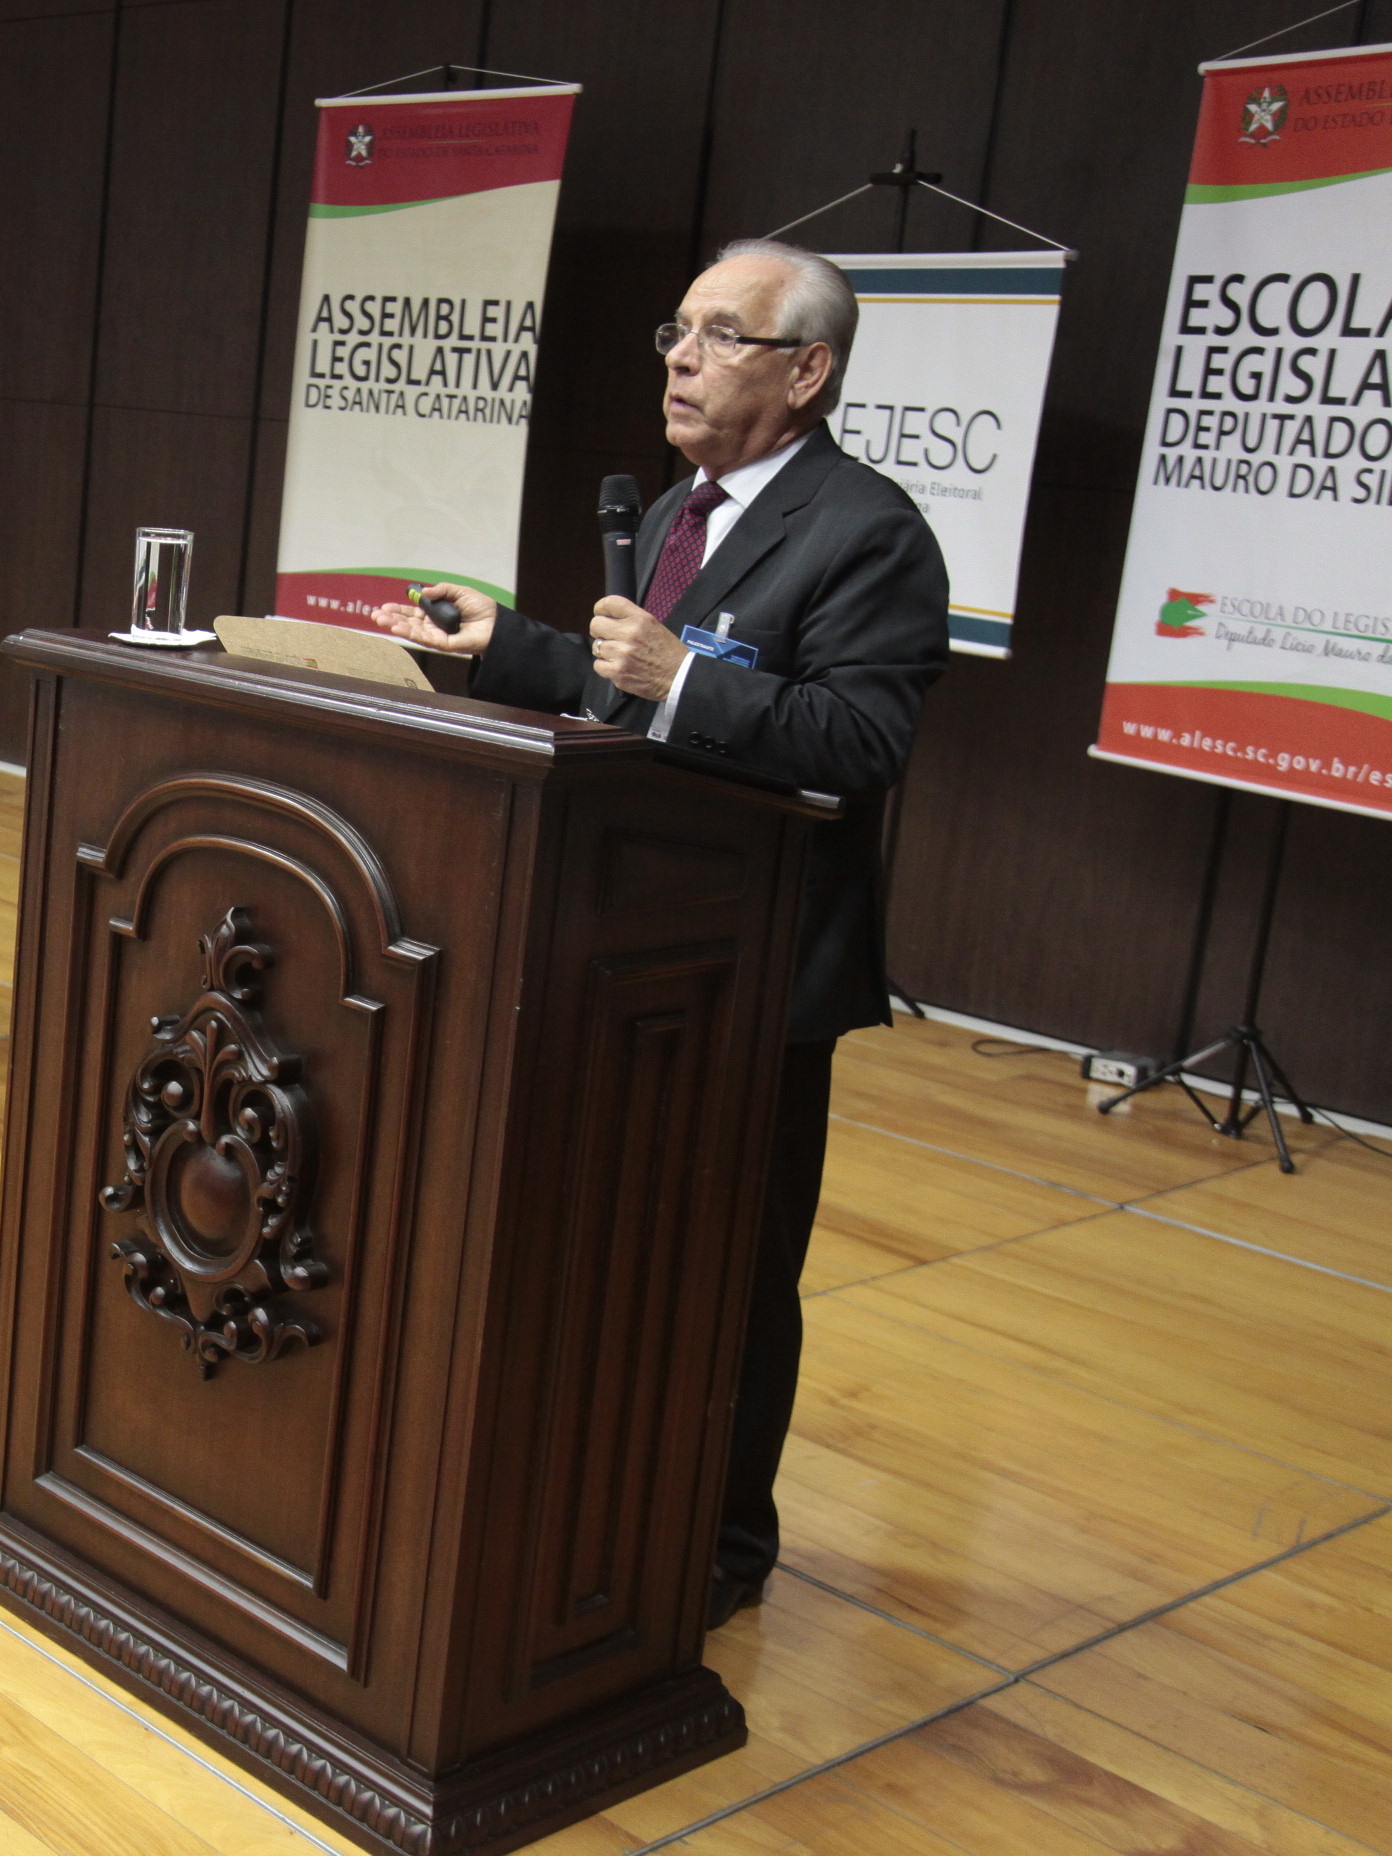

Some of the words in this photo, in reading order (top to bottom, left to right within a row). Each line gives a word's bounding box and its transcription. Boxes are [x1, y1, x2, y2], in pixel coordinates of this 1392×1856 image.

[1298, 80, 1392, 106] ASSEMBL
[310, 293, 539, 345] ASSEMBLEIA
[308, 338, 534, 395] LEGISLATIVA
[1167, 344, 1392, 408] LEGISLA
[304, 383, 333, 410] DE
[338, 385, 408, 417] SANTA
[414, 391, 530, 426] CATARINA
[839, 402, 1002, 474] EJESC
[1160, 407, 1392, 463] DEPUTADO
[929, 481, 983, 500] Eleitoral
[1152, 452, 1278, 496] MAURO
[1287, 462, 1340, 502] DA
[1351, 467, 1392, 507] SI
[1214, 621, 1276, 651] Deputado
[1219, 596, 1286, 622] ESCOLA
[1292, 605, 1326, 627] DO
[1331, 611, 1392, 636] LEGIS
